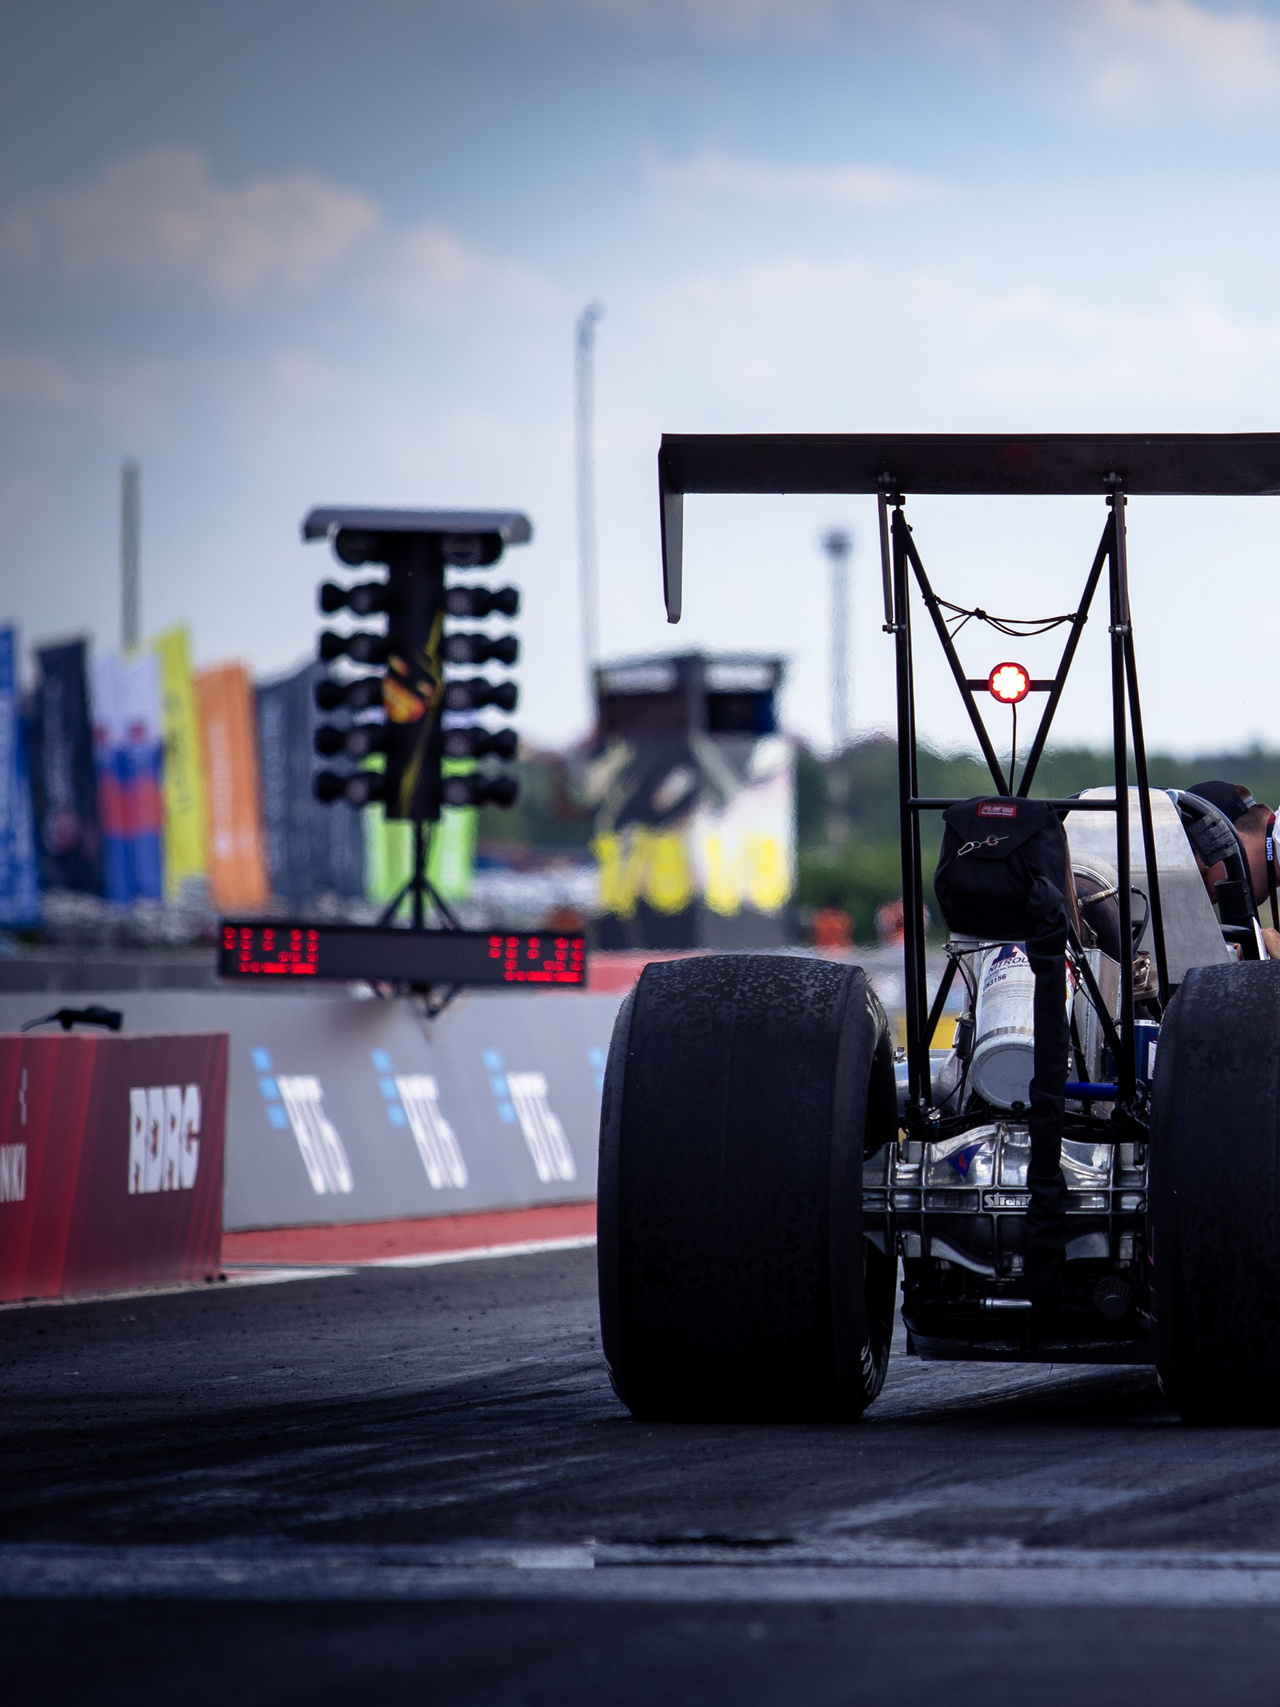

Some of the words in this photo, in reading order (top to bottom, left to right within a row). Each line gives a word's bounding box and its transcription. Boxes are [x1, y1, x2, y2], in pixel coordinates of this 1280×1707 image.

[1266, 836, 1274, 861] RDRC
[988, 956, 1030, 975] NITROU
[129, 1083, 201, 1195] RDRC
[984, 1192, 1032, 1208] Stran
